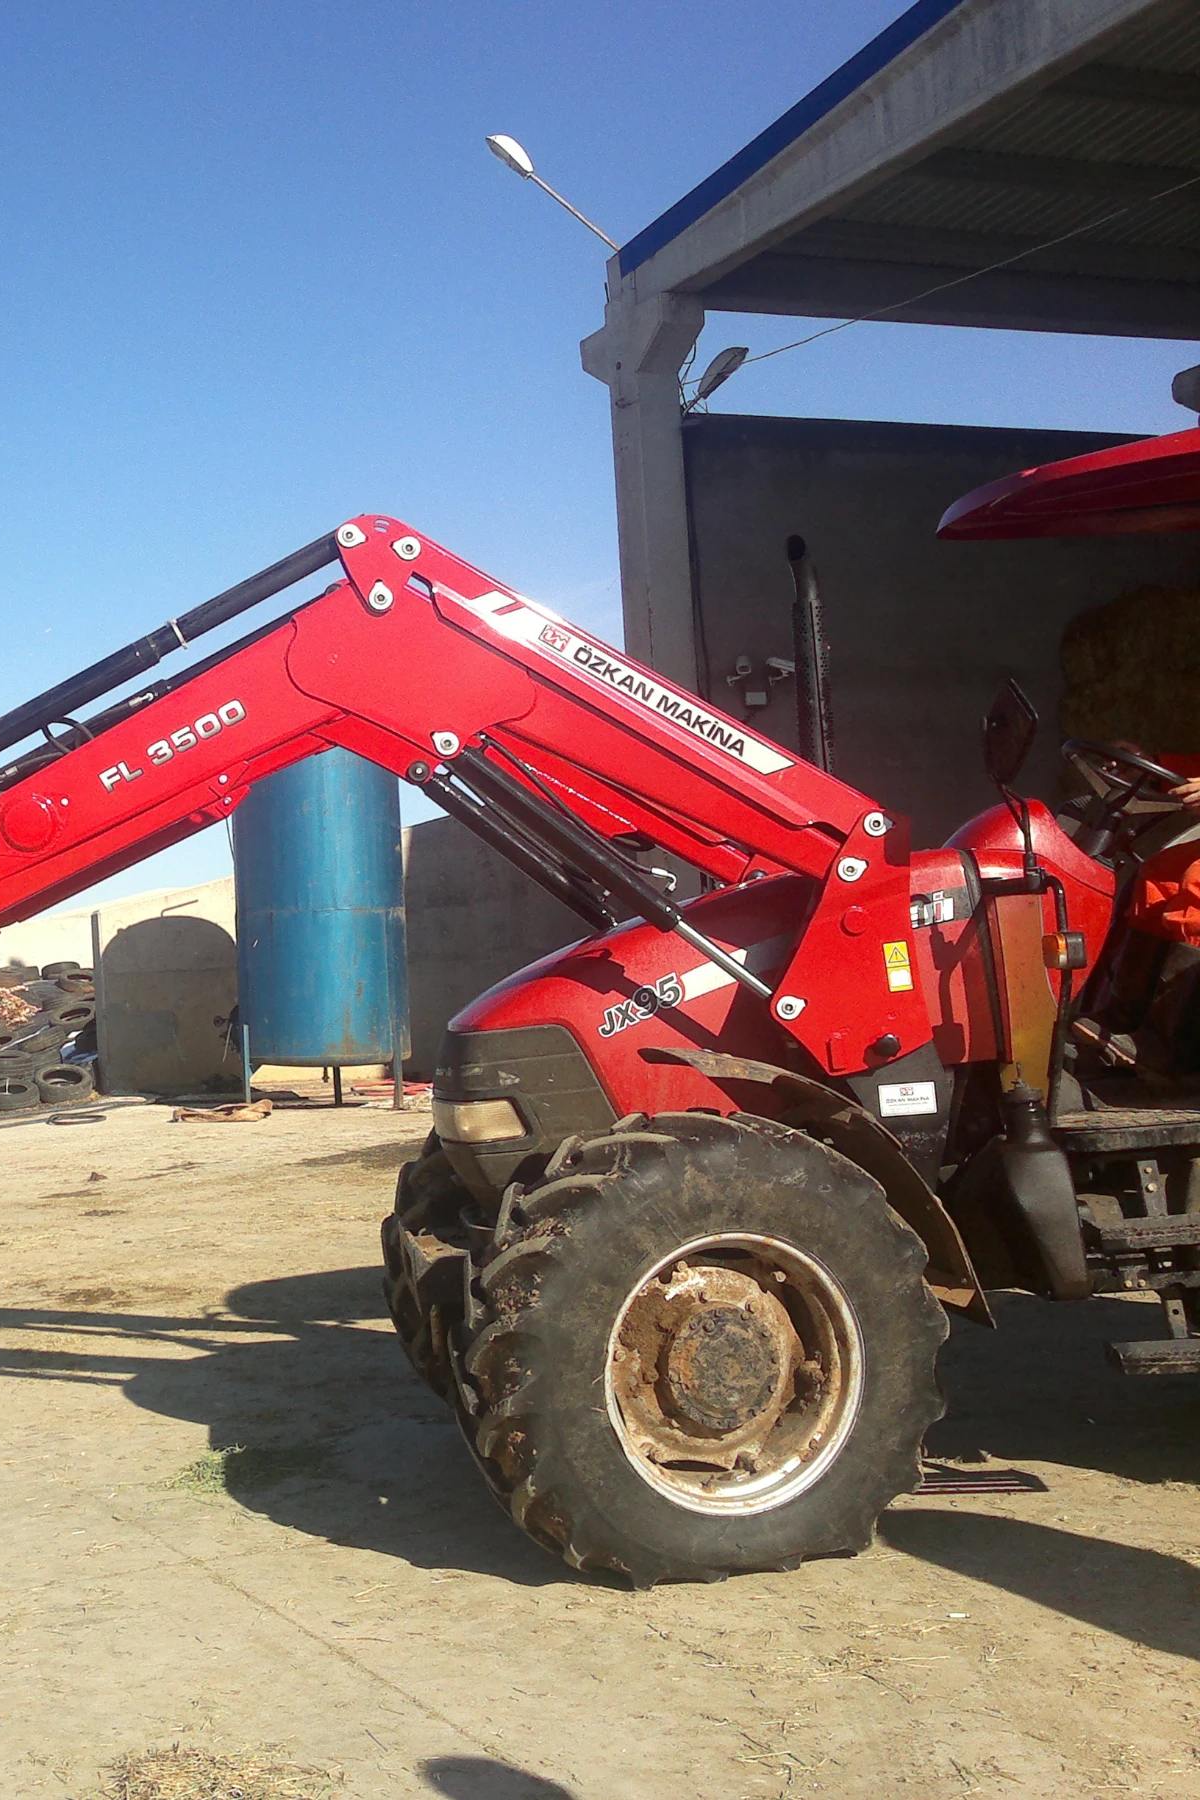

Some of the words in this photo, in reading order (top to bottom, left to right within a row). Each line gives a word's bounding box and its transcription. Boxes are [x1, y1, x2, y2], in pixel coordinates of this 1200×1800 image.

[98, 761, 143, 793] FL
[146, 699, 247, 766] 3500
[573, 645, 654, 702] ÖZKAN
[656, 695, 745, 757] MAKİNA
[597, 971, 683, 1038] JX95
